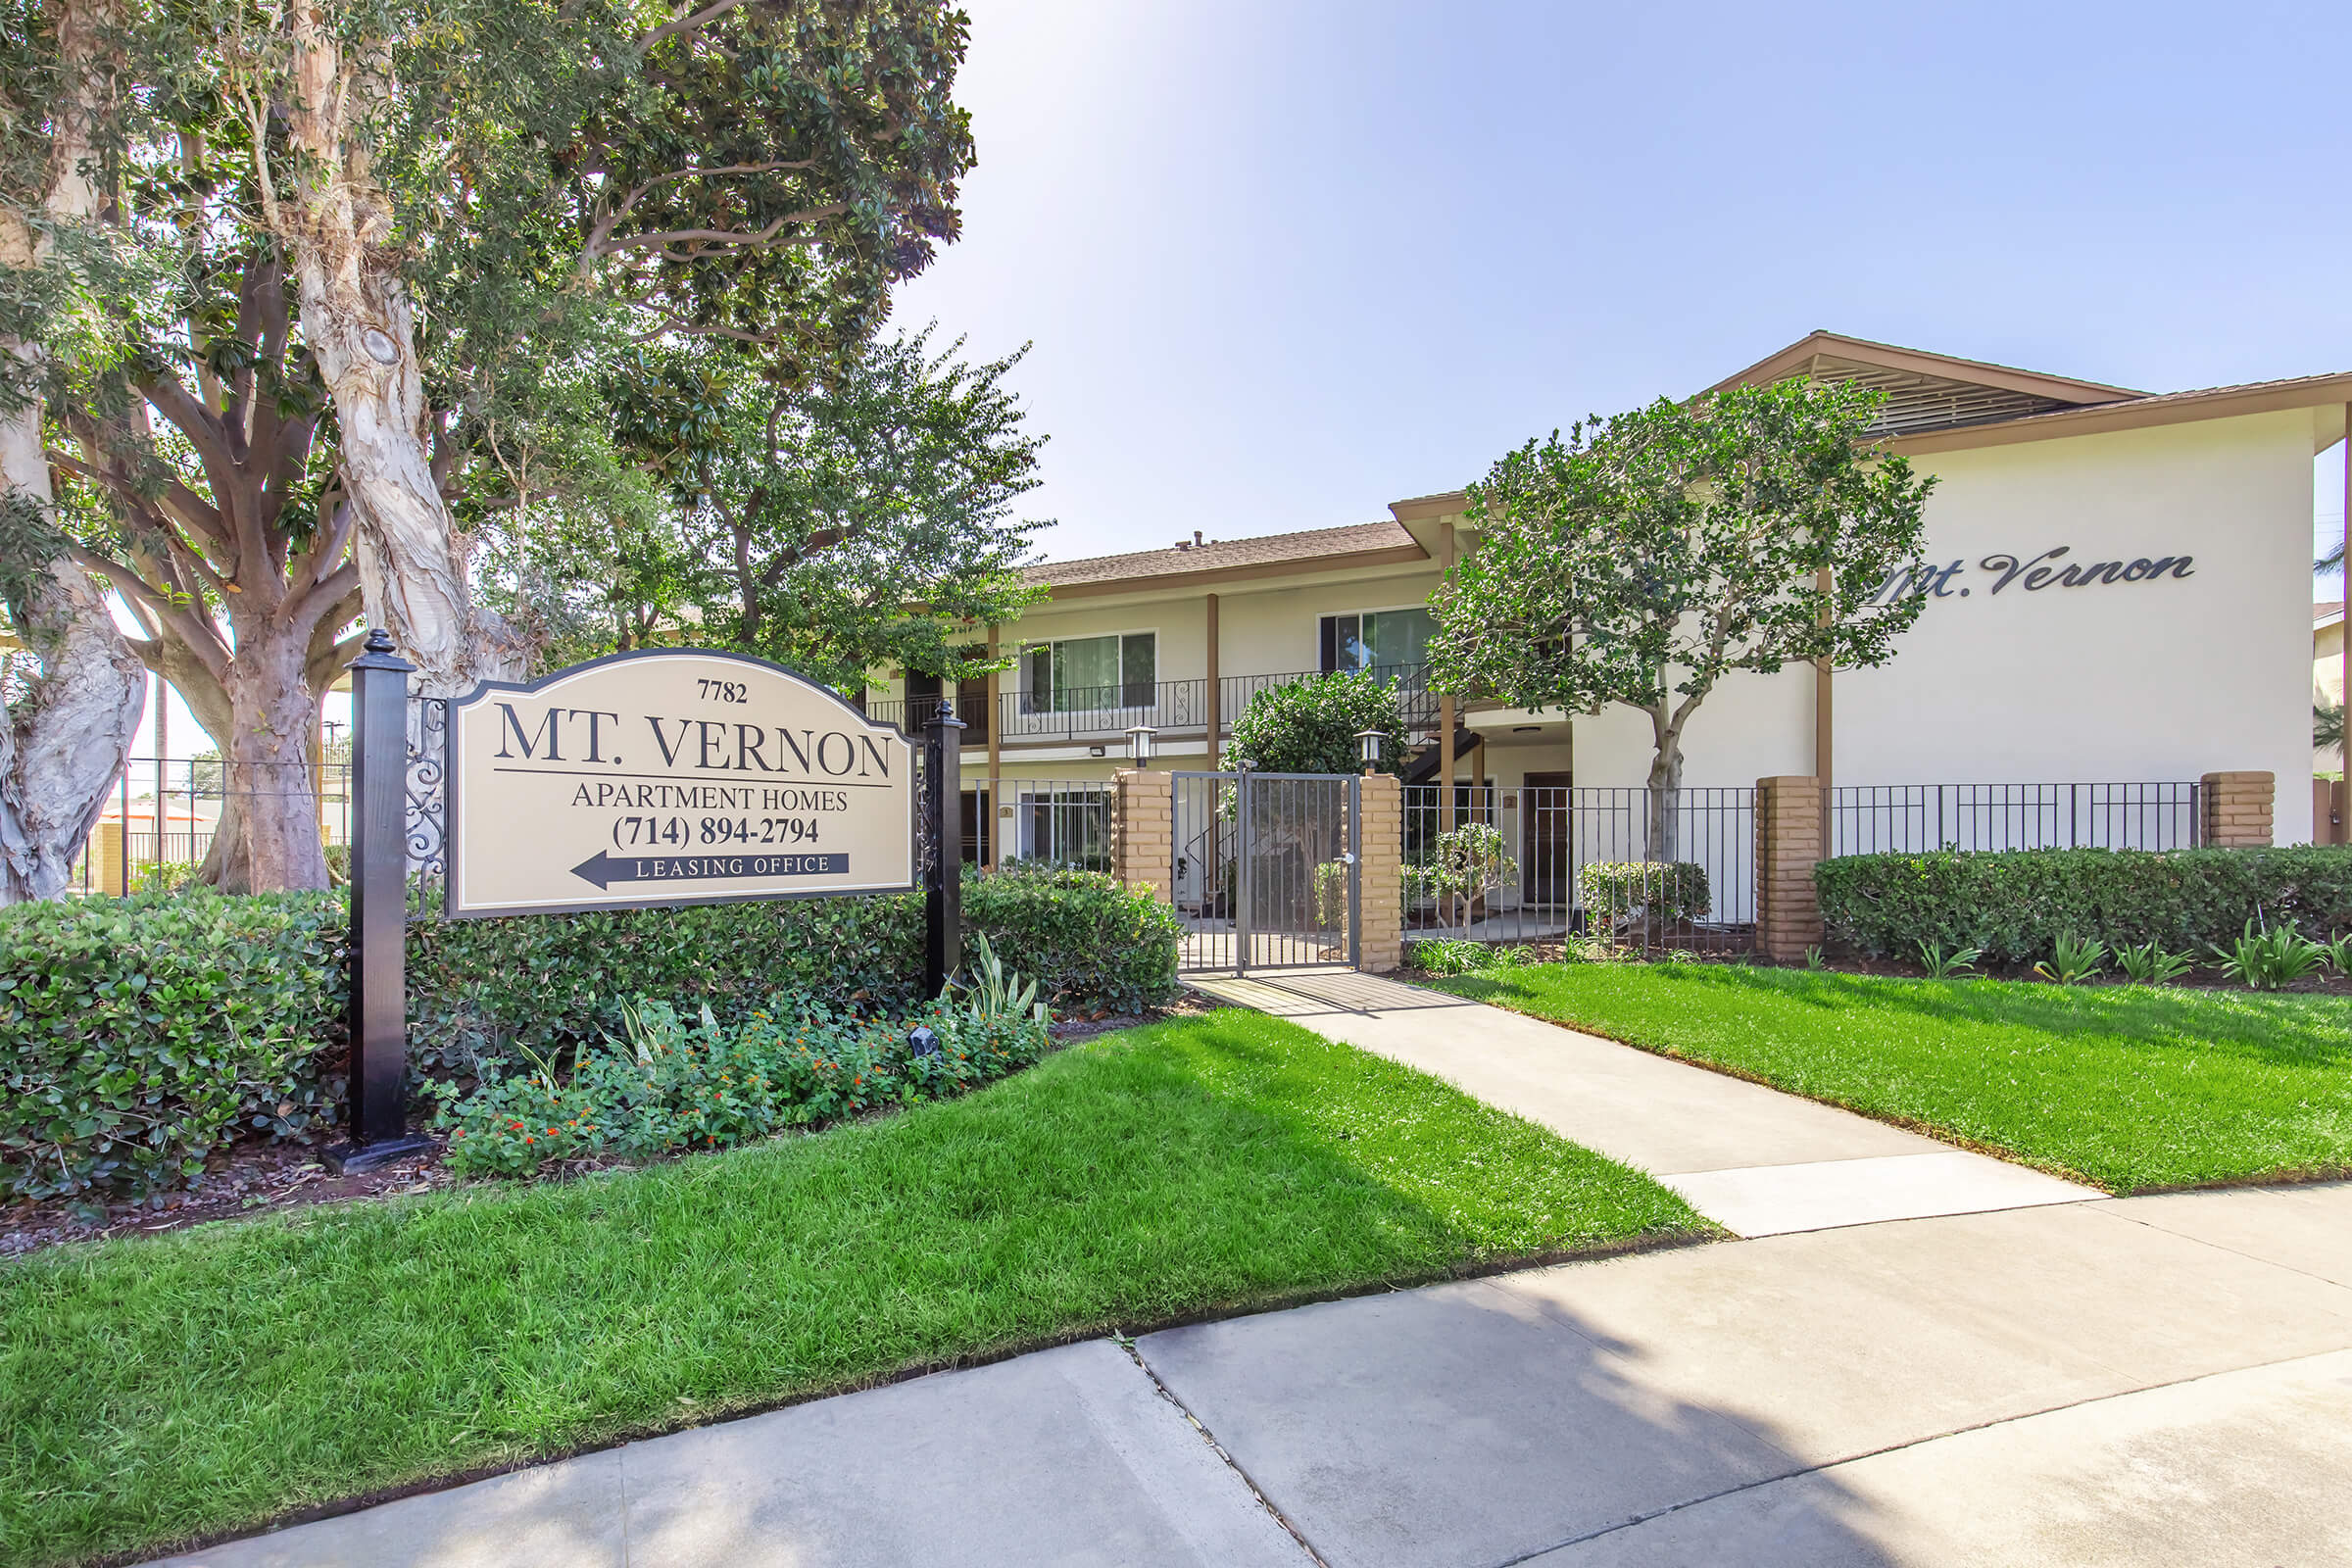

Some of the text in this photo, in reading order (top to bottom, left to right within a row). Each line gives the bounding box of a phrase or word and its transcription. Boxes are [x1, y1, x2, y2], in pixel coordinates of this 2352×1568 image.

[1980, 546, 2195, 595] Vernon
[697, 678, 748, 705] 7782
[494, 703, 893, 778] MT. VERNON
[571, 781, 848, 812] APARTMENT HOMES
[612, 816, 819, 851] (714) 894-2794
[635, 856, 830, 878] LEASING OFFICE
